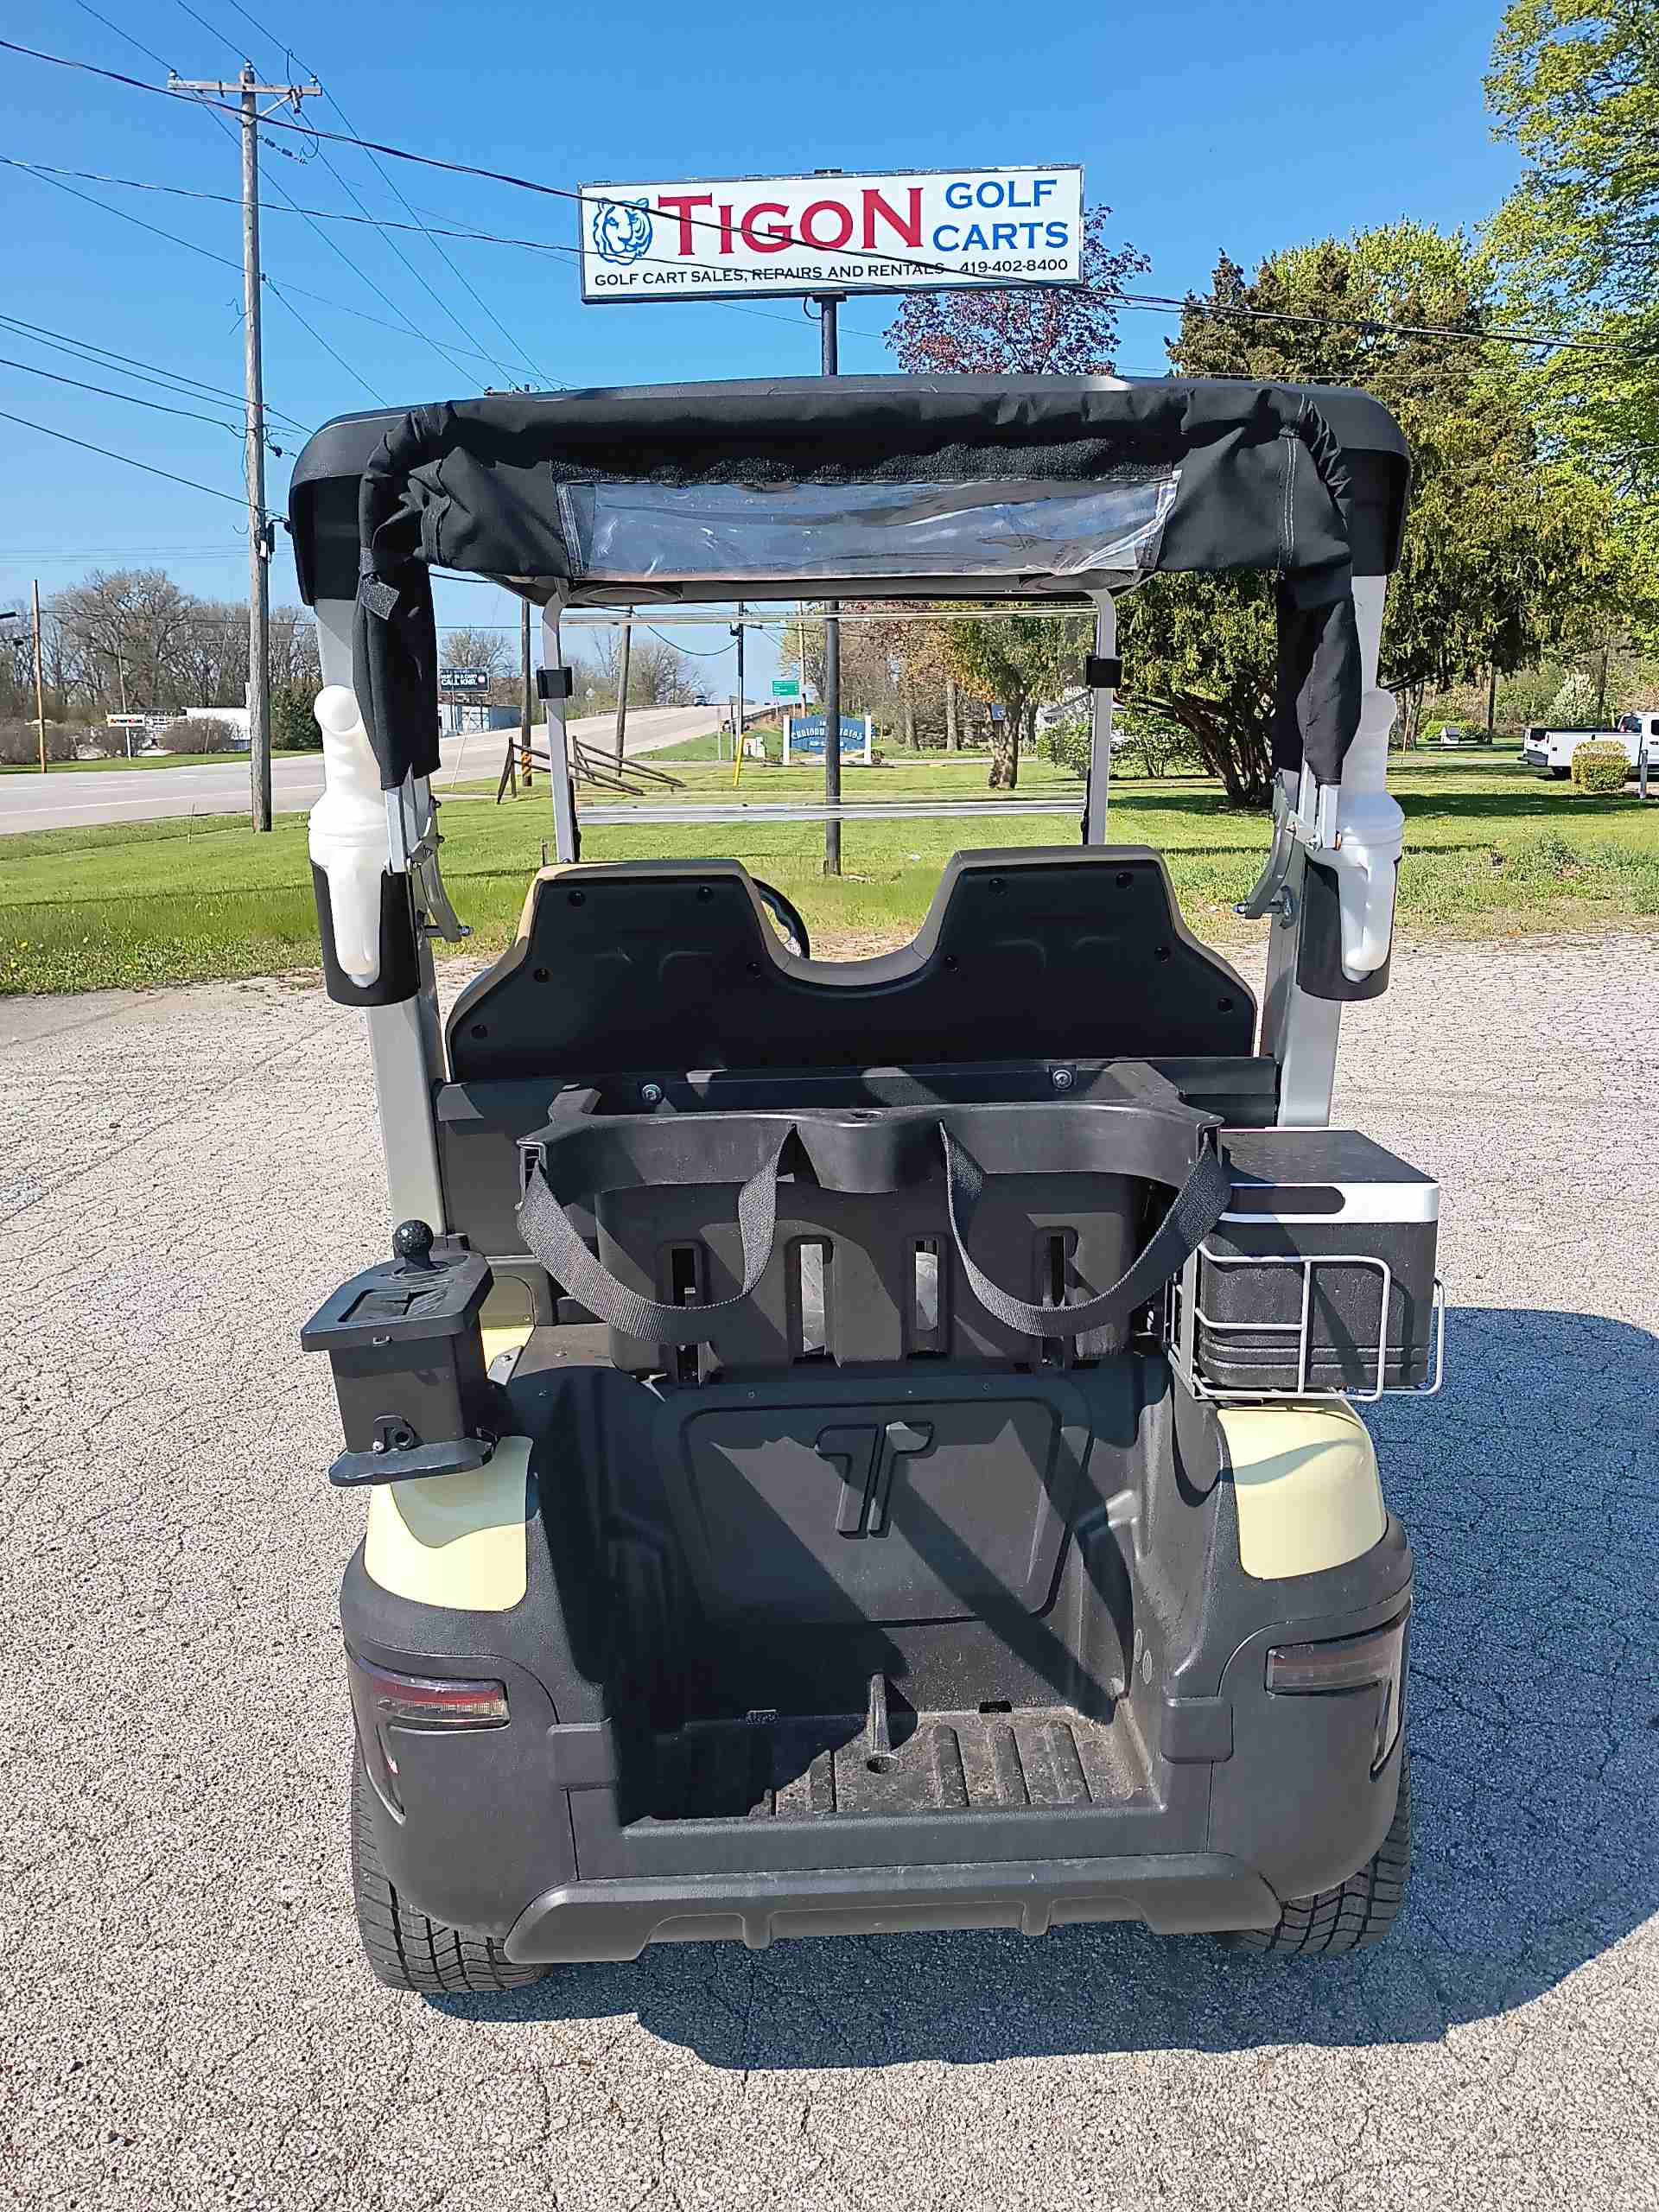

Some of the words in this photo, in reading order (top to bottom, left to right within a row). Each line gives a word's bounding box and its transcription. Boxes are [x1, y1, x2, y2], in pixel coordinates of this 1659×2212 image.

[945, 179, 1058, 209] GOLF
[658, 187, 925, 257] TIGON
[932, 221, 1070, 252] CARTS
[594, 273, 639, 286] GOLF
[642, 271, 688, 285] CART
[690, 269, 748, 283] SALES,
[752, 266, 823, 281] REPAIRS
[827, 264, 864, 278] AND
[868, 262, 945, 277] RENTALS
[959, 258, 1069, 274] 419-402-8400
